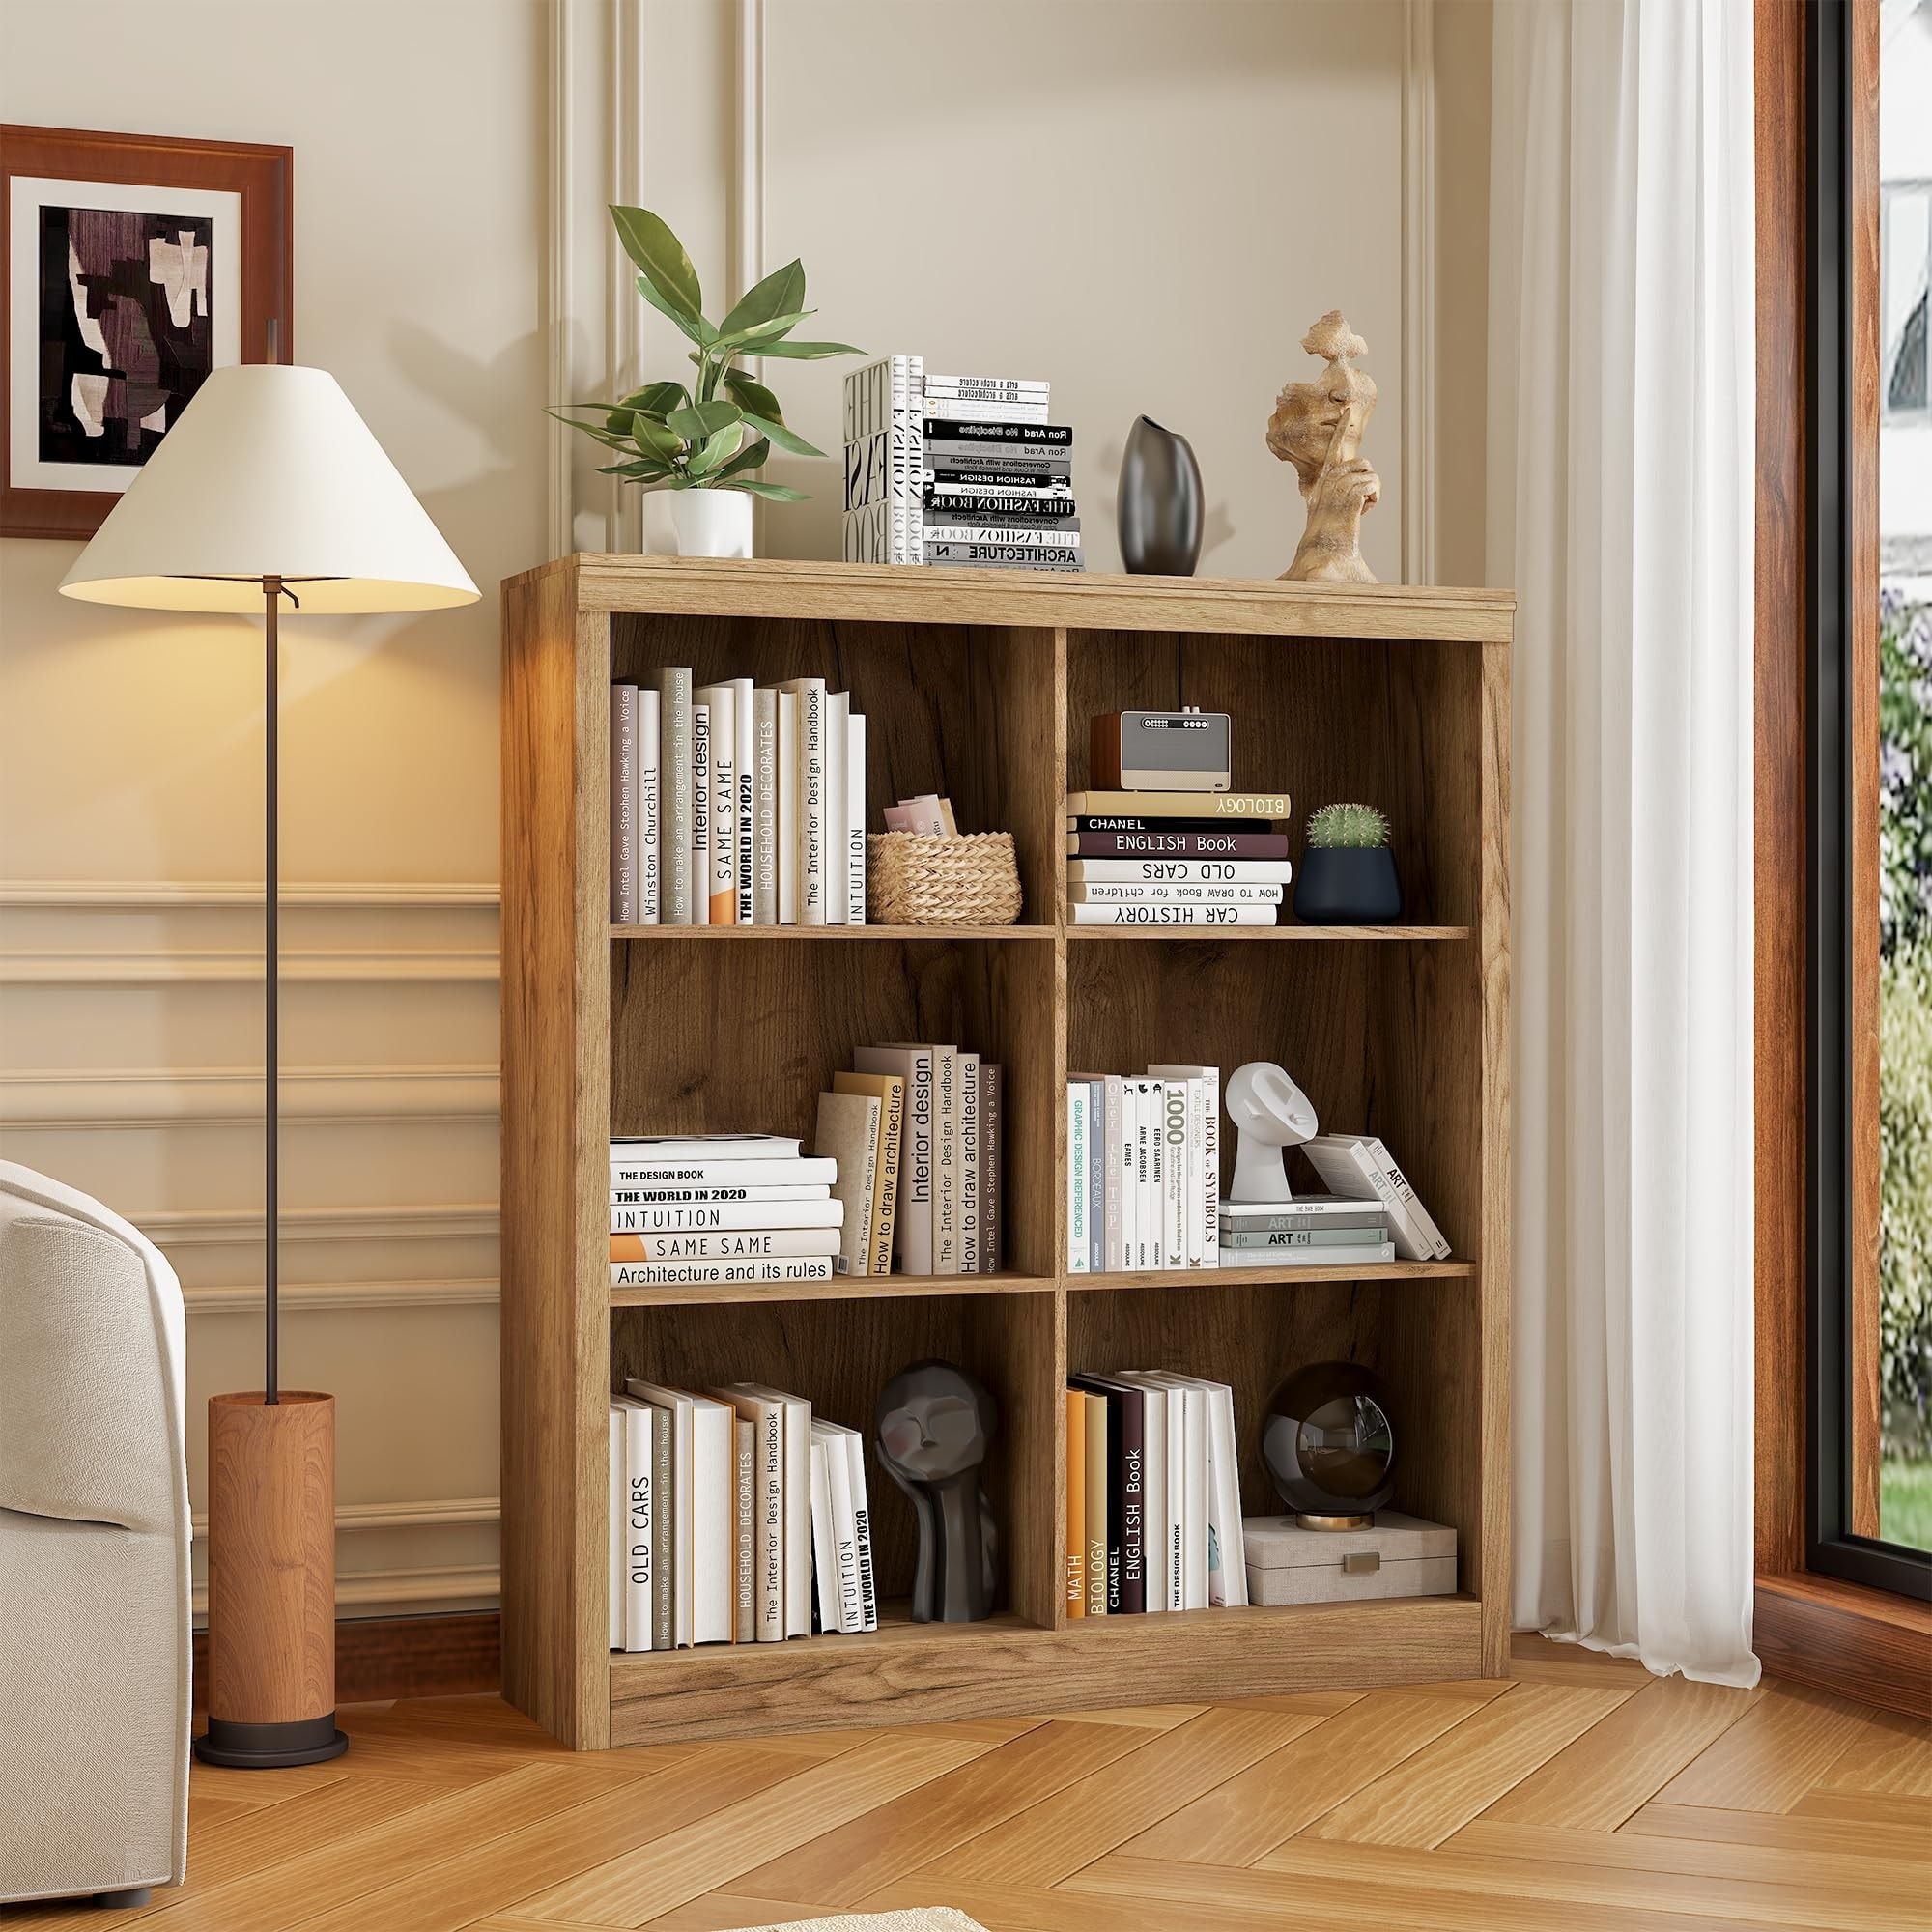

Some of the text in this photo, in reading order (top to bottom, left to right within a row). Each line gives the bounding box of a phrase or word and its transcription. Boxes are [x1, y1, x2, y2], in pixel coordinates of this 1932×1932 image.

[620, 690, 629, 722] Voice
[620, 737, 632, 781] Hawking
[674, 734, 683, 747] in
[675, 753, 685, 822] arrangement
[692, 712, 710, 851] Interior design
[807, 688, 820, 906] The Interior Design Handbook
[620, 787, 631, 829] Stephen
[718, 760, 732, 879] SAME SAME
[760, 721, 773, 890] HOUSEHOLD DECORATES
[1089, 819, 1145, 830] CHANEL
[1216, 798, 1284, 813] BIOLOGY
[620, 836, 629, 860] Gave
[644, 767, 657, 915] Winston Churchill
[677, 828, 683, 840] an
[740, 774, 752, 920] THE WORLD IN 2020
[1116, 836, 1236, 851] ENGLISH Book
[620, 867, 629, 895] Intel
[675, 877, 683, 890] to
[851, 829, 863, 921] INTUITION
[1143, 864, 1235, 879] OLD CARS
[620, 900, 629, 921] How
[1092, 888, 1278, 897] HOW TO DRAW Book for children
[1115, 908, 1238, 922] CAR HISTORY
[868, 1103, 878, 1151] Handbook
[911, 1058, 933, 1203] Interior design
[987, 1111, 997, 1151] Hawking
[1166, 1089, 1185, 1145] 1000
[1205, 1116, 1216, 1156] BOOK
[620, 1170, 703, 1180] THE DESIGN BOOK
[865, 1156, 874, 1191] Design
[941, 1055, 953, 1262] The Interior Design Handbook
[961, 1063, 976, 1272] How to draw architecture
[987, 1155, 997, 1193] Stephen
[1387, 1168, 1406, 1189] ART
[615, 1190, 747, 1202] THE WORLD IN 2020
[874, 1084, 901, 1274] How to draw architecture
[1092, 1158, 1101, 1208] BORDEAUX
[1368, 1171, 1387, 1192] ART
[617, 1209, 720, 1228] INTUITION
[861, 1197, 871, 1242] Interior
[1205, 1172, 1217, 1243] SYMBOLS
[1268, 1216, 1293, 1229] ART
[656, 1236, 772, 1256] SAME SAME
[986, 1227, 995, 1253] Intel
[1268, 1233, 1293, 1245] ART
[618, 1263, 826, 1283] Architecture and its rules
[661, 1473, 668, 1486] in
[631, 1476, 649, 1584] OLD CARS
[661, 1491, 670, 1552] arrangement
[739, 1452, 752, 1608] HOUSEHOLD DECORATES
[766, 1412, 780, 1622] The Interior Design Handbook
[1125, 1448, 1141, 1580] ENGLISH Book
[662, 1558, 668, 1572] an
[839, 1541, 859, 1627] INTUITION
[856, 1510, 876, 1626] THE WORLD IN 2020
[1068, 1554, 1082, 1601] MATH
[1091, 1539, 1105, 1614] BIOLOGY
[1110, 1547, 1120, 1608] CHANEL
[661, 1605, 668, 1617] to
[660, 1625, 668, 1640] How
